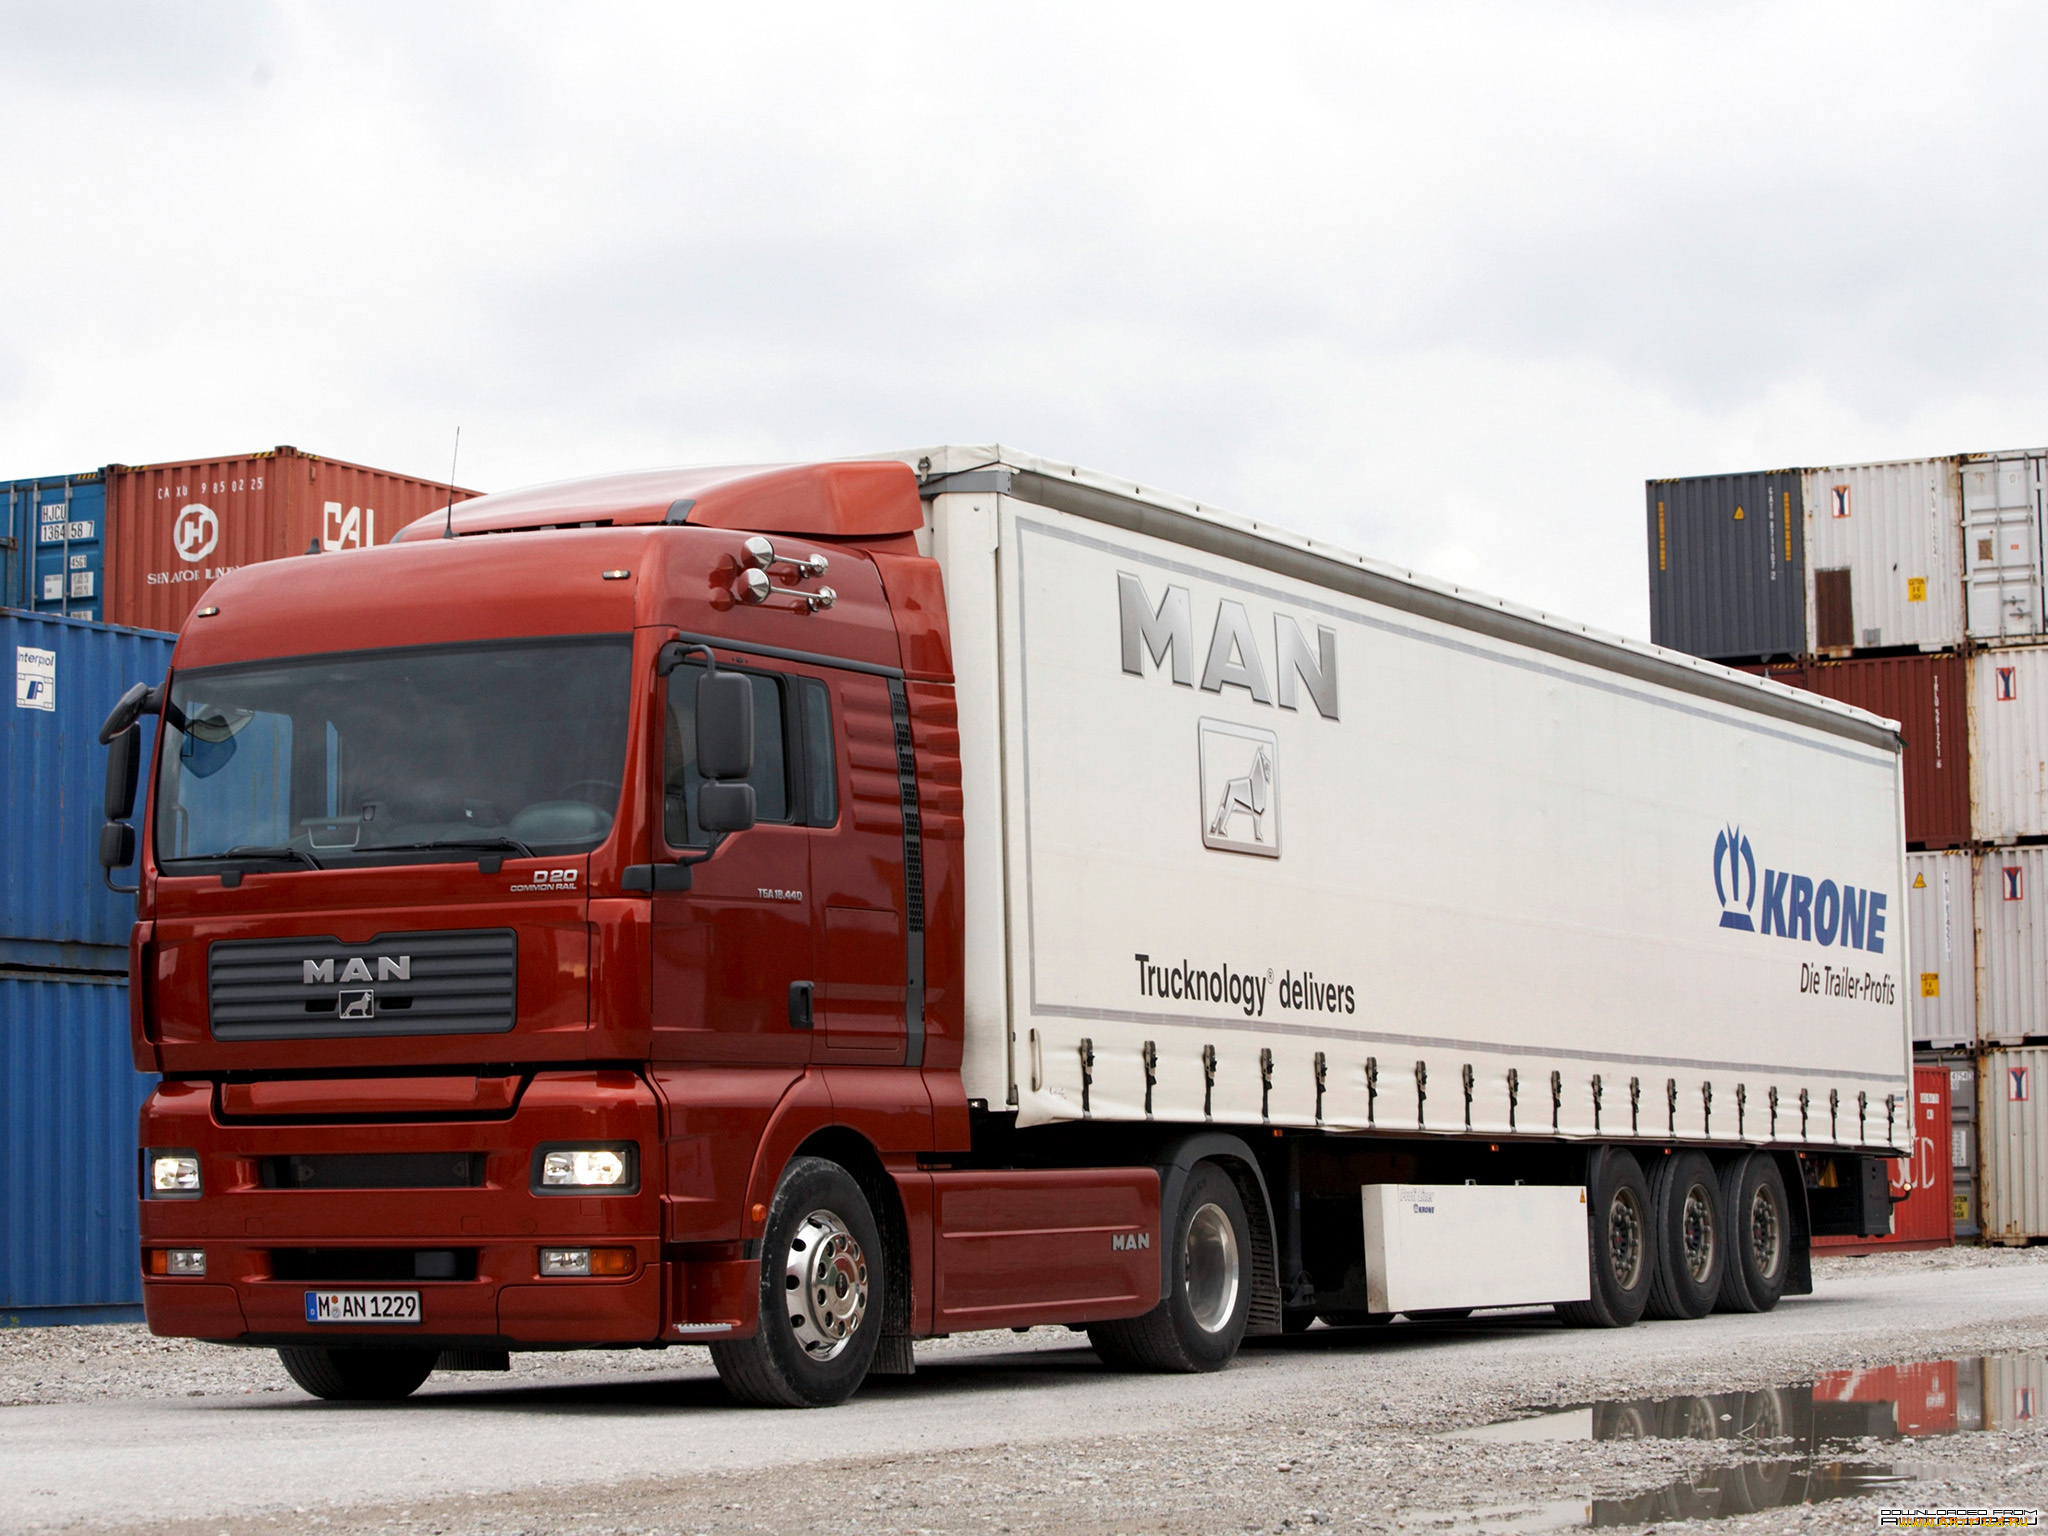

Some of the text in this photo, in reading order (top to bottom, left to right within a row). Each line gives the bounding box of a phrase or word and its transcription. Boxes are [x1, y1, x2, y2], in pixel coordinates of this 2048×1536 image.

[42, 505, 67, 521] HJCU
[1117, 570, 1340, 722] MAN
[510, 884, 554, 892] COMMON
[1761, 868, 1887, 954] KRONE
[303, 956, 410, 984] MAN
[1800, 962, 1820, 994] Die
[1824, 966, 1895, 1005] Trailer-Profis
[1279, 969, 1355, 1014] delivers
[1112, 1232, 1150, 1251] MAN
[318, 1296, 330, 1317] M
[343, 1296, 366, 1317] AN
[370, 1296, 417, 1317] 1229
